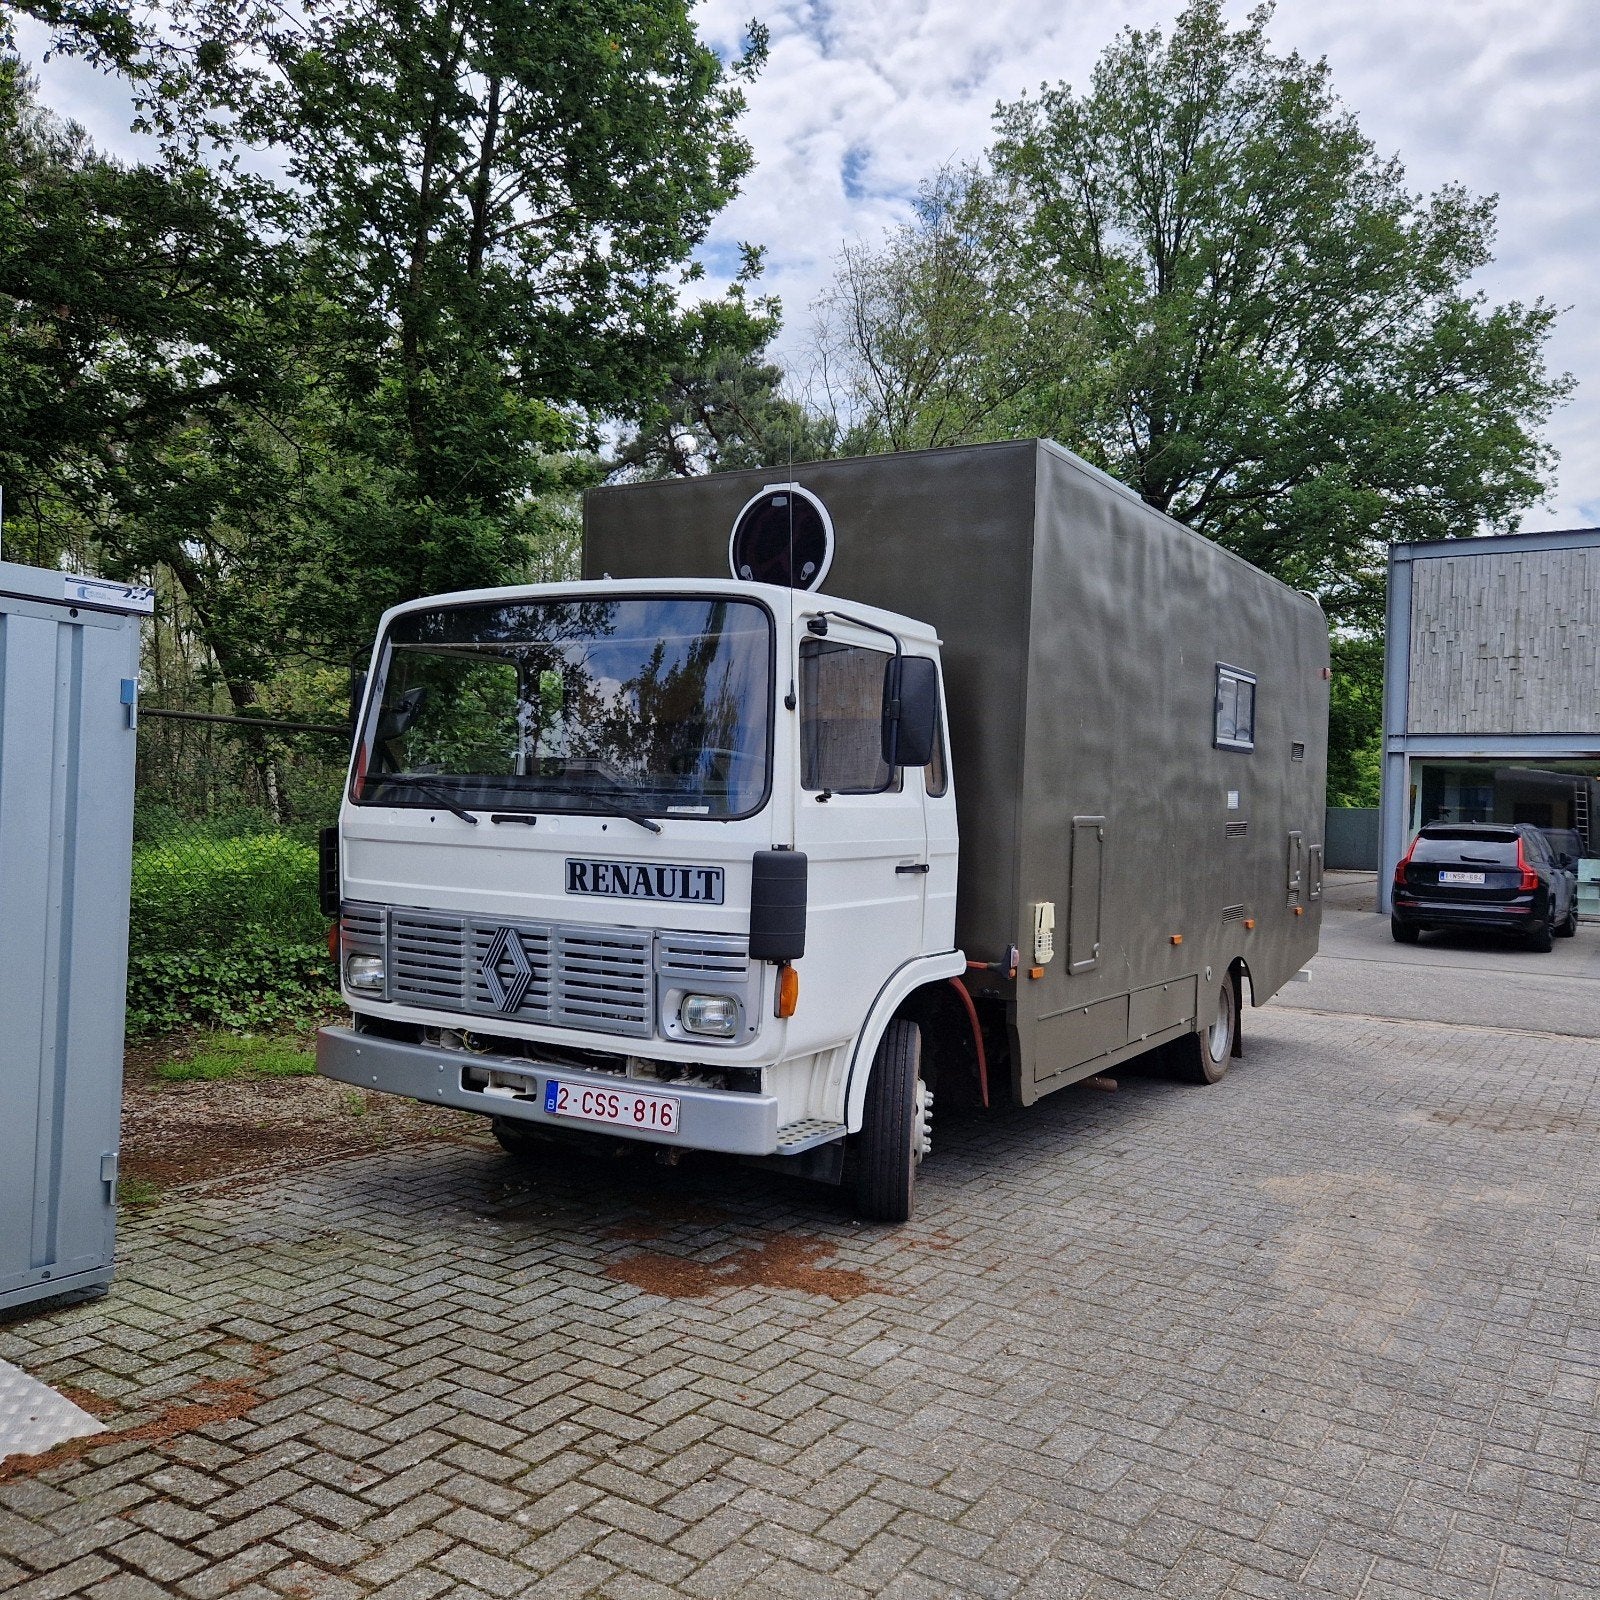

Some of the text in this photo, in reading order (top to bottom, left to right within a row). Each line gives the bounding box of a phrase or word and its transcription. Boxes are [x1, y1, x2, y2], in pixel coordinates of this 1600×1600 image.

[567, 861, 720, 901] RENAULT
[547, 1087, 673, 1126] B 2-CSS-816
